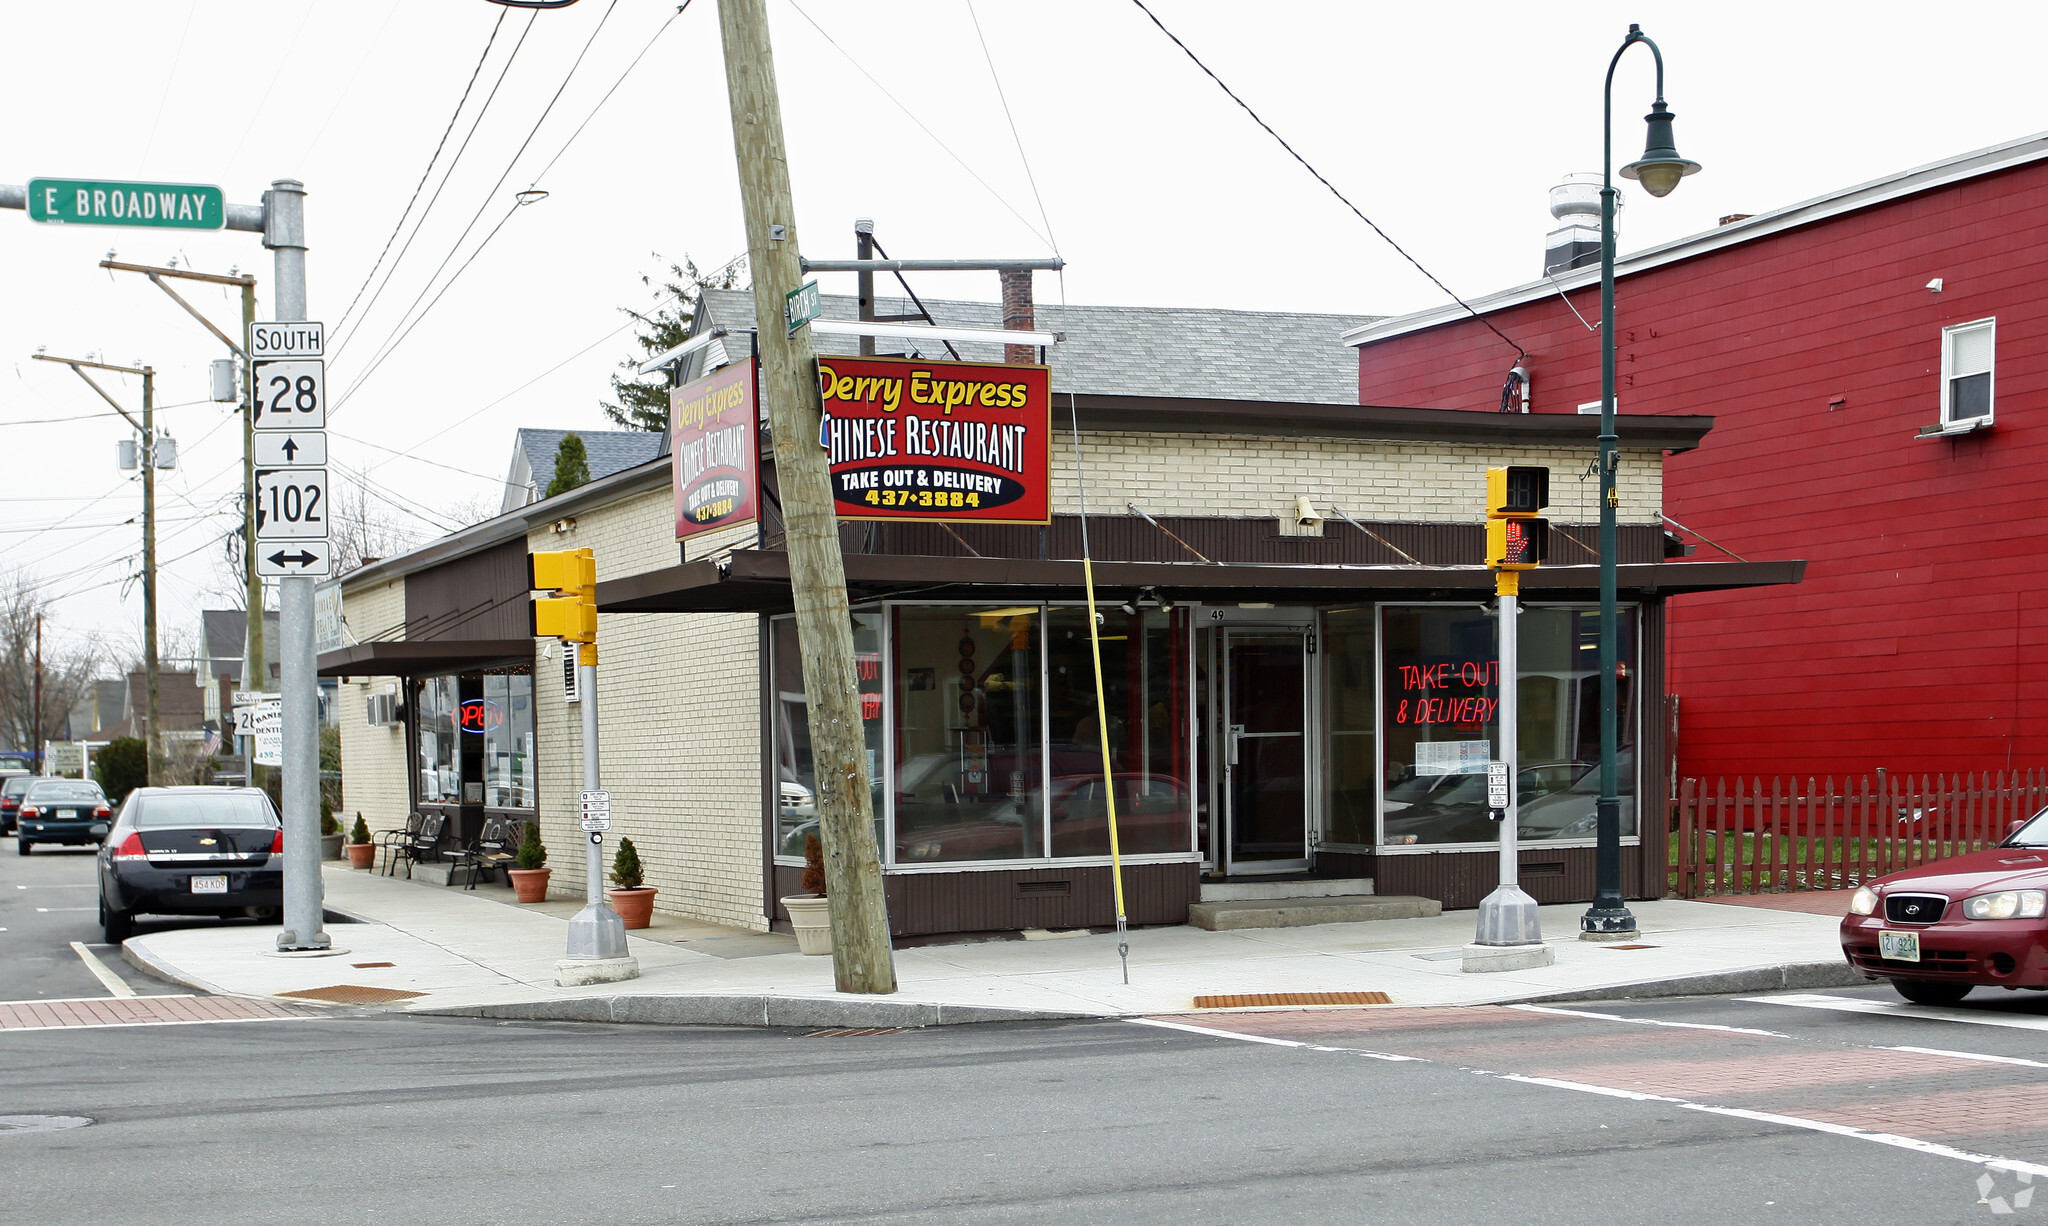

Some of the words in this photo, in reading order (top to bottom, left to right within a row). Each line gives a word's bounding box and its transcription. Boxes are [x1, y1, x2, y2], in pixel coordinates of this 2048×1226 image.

[45, 187, 58, 215] E
[76, 188, 207, 222] BROADWAY
[789, 290, 810, 323] BIRCH
[811, 292, 818, 307] ST
[255, 328, 320, 351] SOUTH
[269, 375, 317, 414] 28
[677, 396, 705, 431] Derry
[705, 379, 745, 424] Express
[819, 365, 903, 413] Derry
[910, 371, 1028, 415] Express
[679, 436, 706, 492] CHINESE
[705, 423, 746, 473] RESTAURANT
[905, 415, 1027, 474] RESTAURANT
[688, 483, 701, 512] TAKE
[700, 483, 712, 504] OUT
[711, 481, 717, 498] &
[716, 479, 740, 498] DELIVERY
[841, 473, 879, 491] TAKE
[883, 470, 914, 488] OUT
[916, 469, 930, 488] &
[933, 470, 1002, 496] DELIVERY
[269, 484, 322, 523] 102
[1211, 609, 1225, 621] 49
[1398, 660, 1499, 691] TAKE-OUT
[450, 704, 504, 727] OPEN
[1396, 699, 1409, 724] &
[1413, 697, 1498, 724] DELIVERY
[193, 880, 209, 890] 454
